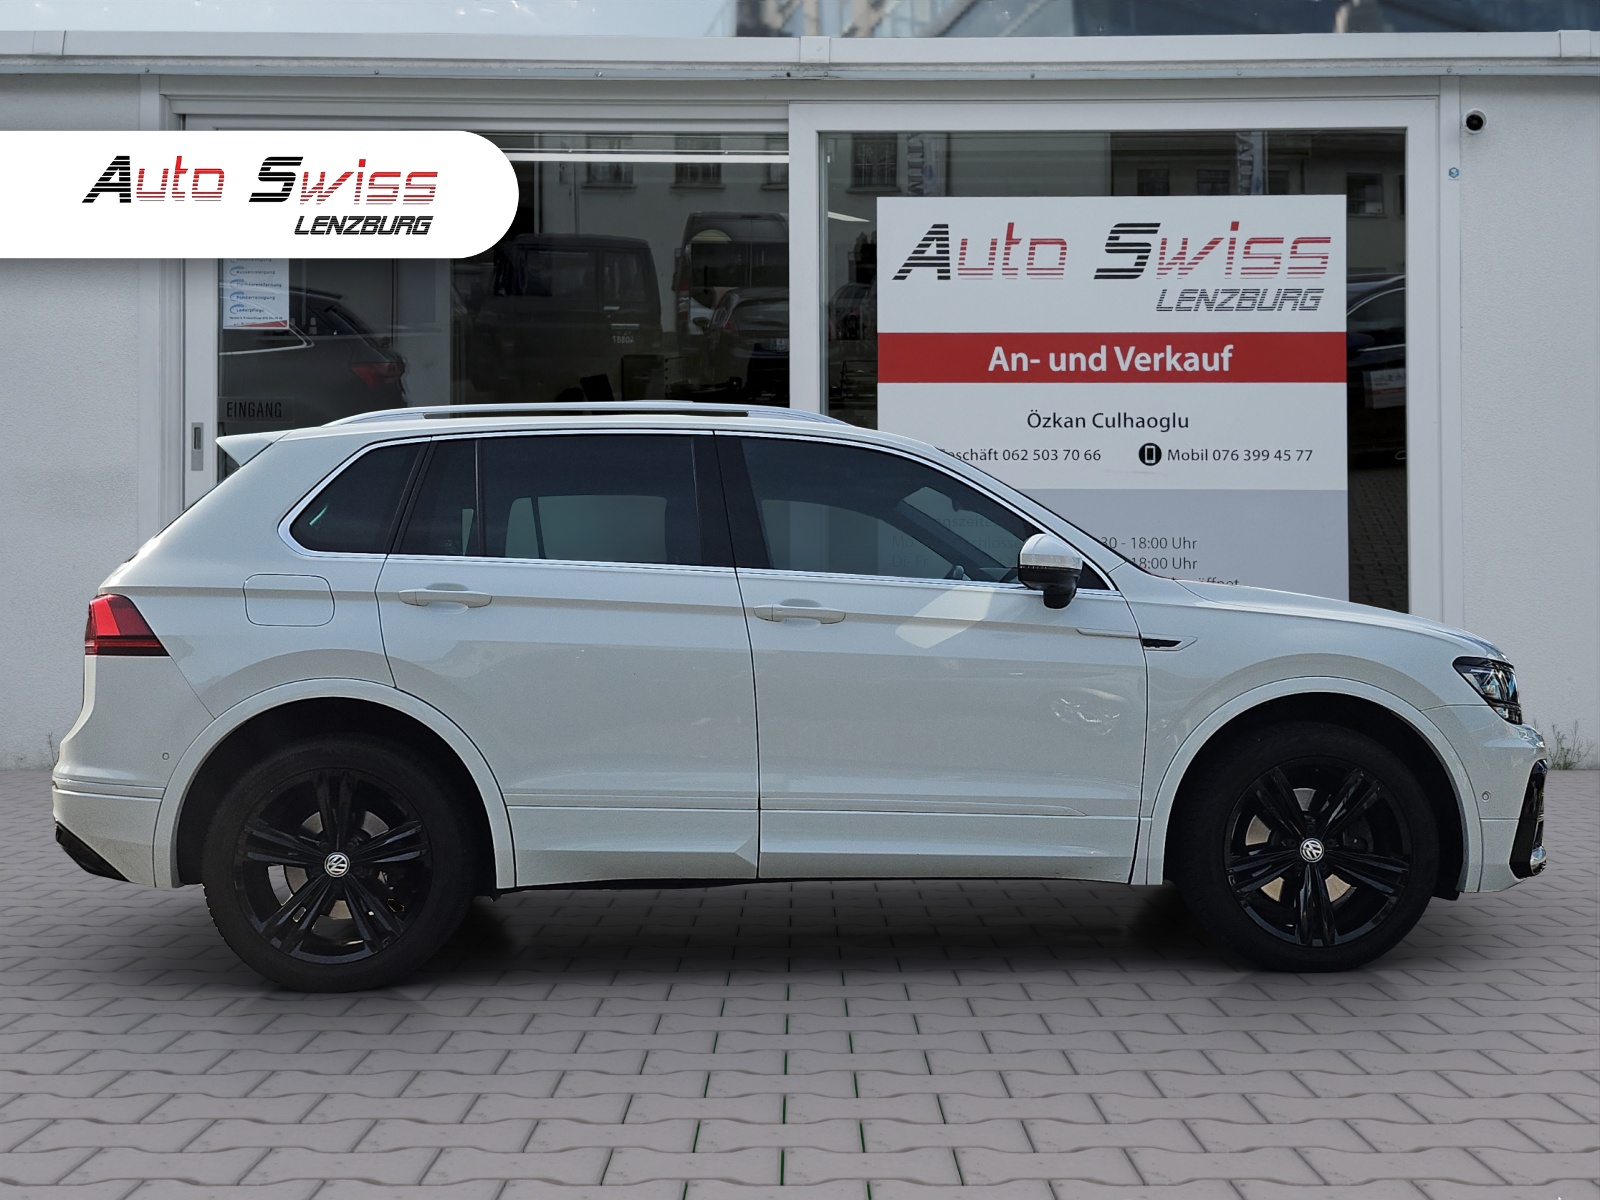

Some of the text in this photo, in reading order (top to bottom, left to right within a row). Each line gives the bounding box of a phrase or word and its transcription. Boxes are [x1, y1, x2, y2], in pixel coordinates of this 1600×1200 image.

[892, 221, 1331, 281] Auto Swiss
[1156, 288, 1325, 312] LENZBURG
[988, 344, 1234, 372] An- und Verkauf
[226, 401, 282, 418] EINGANG
[1027, 409, 1189, 433] Özkan Culhaoglu
[940, 448, 1102, 461] eschäft 062 503 70 66
[1167, 448, 1313, 462] Mobil 076 399 45 77
[1131, 536, 1168, 550] 18:00
[1171, 536, 1198, 550] Uhr
[1171, 556, 1198, 570] Uhr
